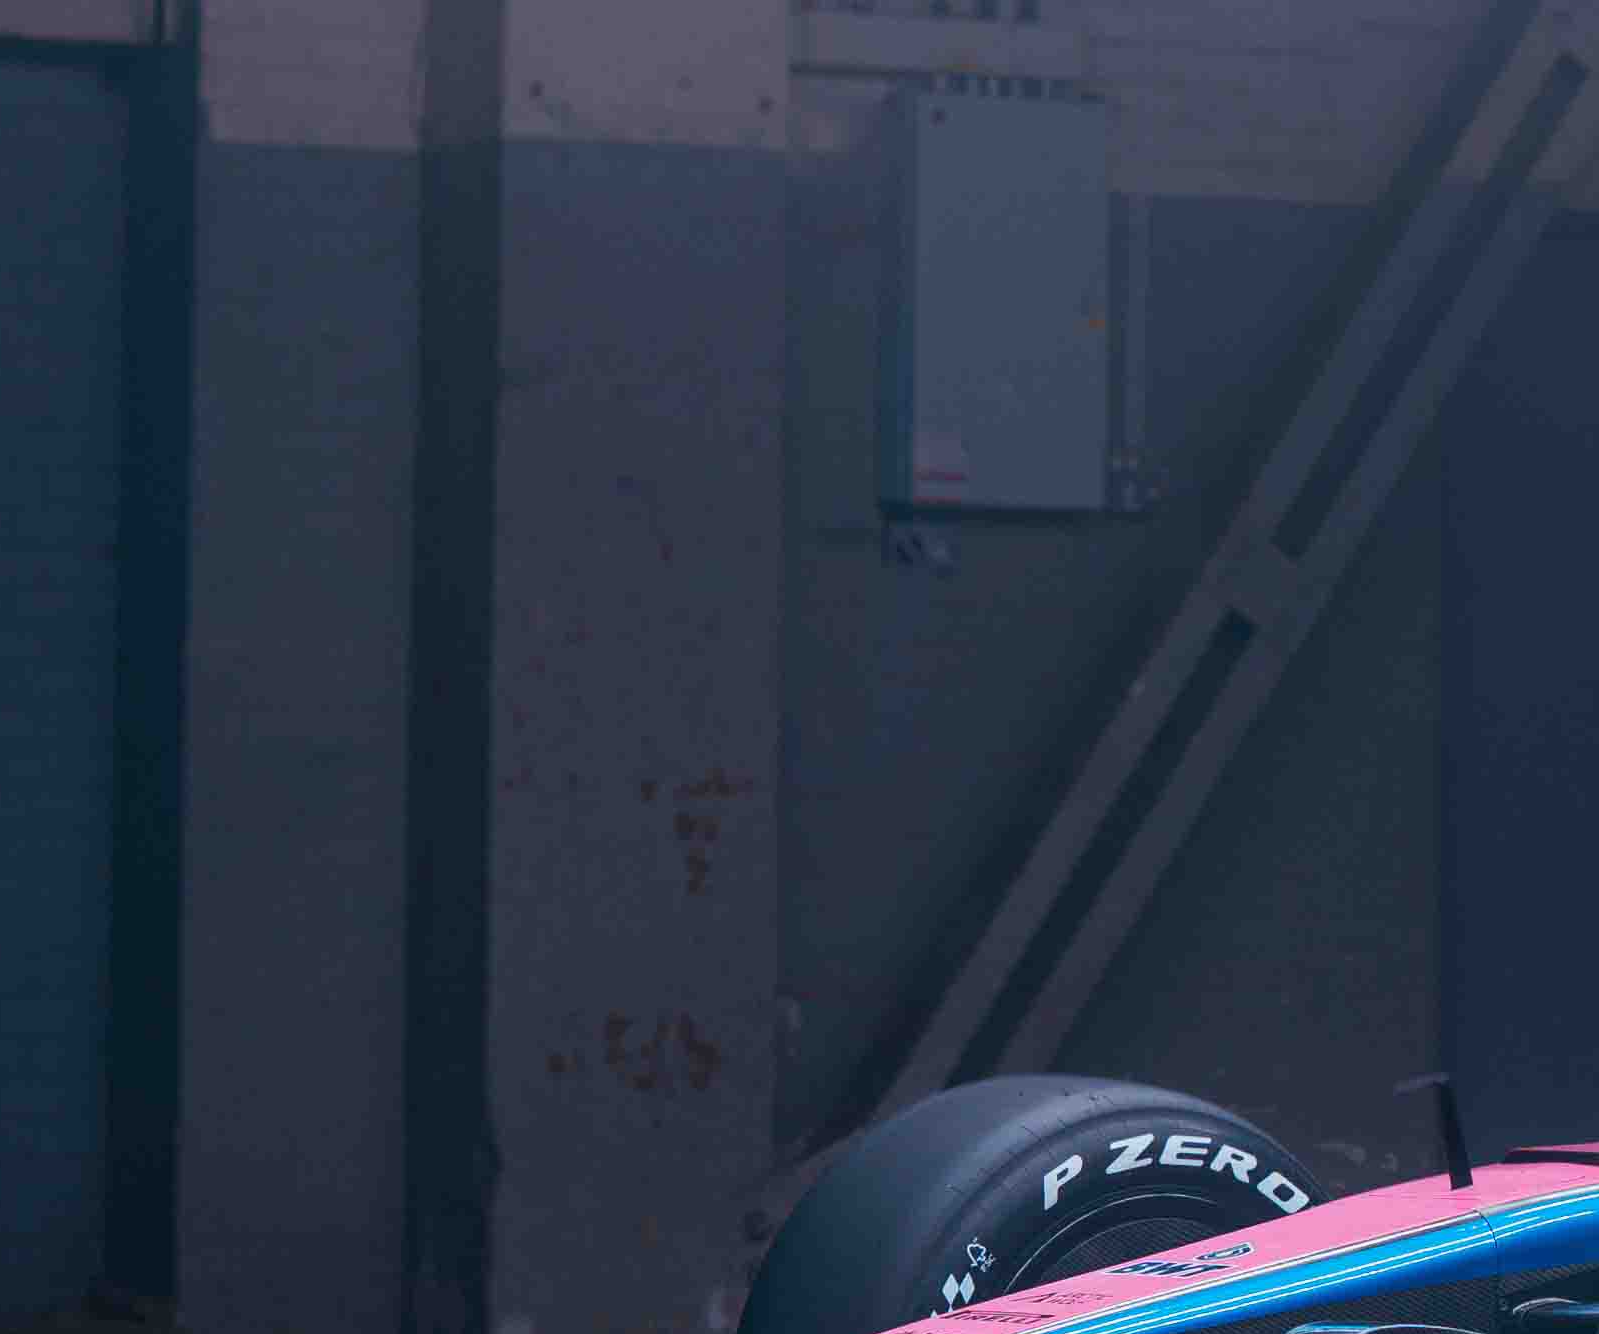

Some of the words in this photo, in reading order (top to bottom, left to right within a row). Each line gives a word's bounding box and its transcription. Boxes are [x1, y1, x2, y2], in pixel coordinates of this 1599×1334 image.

[1043, 1153, 1085, 1211] P
[1105, 1132, 1310, 1214] ZERO
[1105, 1259, 1233, 1279] BWT
[941, 1309, 1056, 1325] PIRELLI
